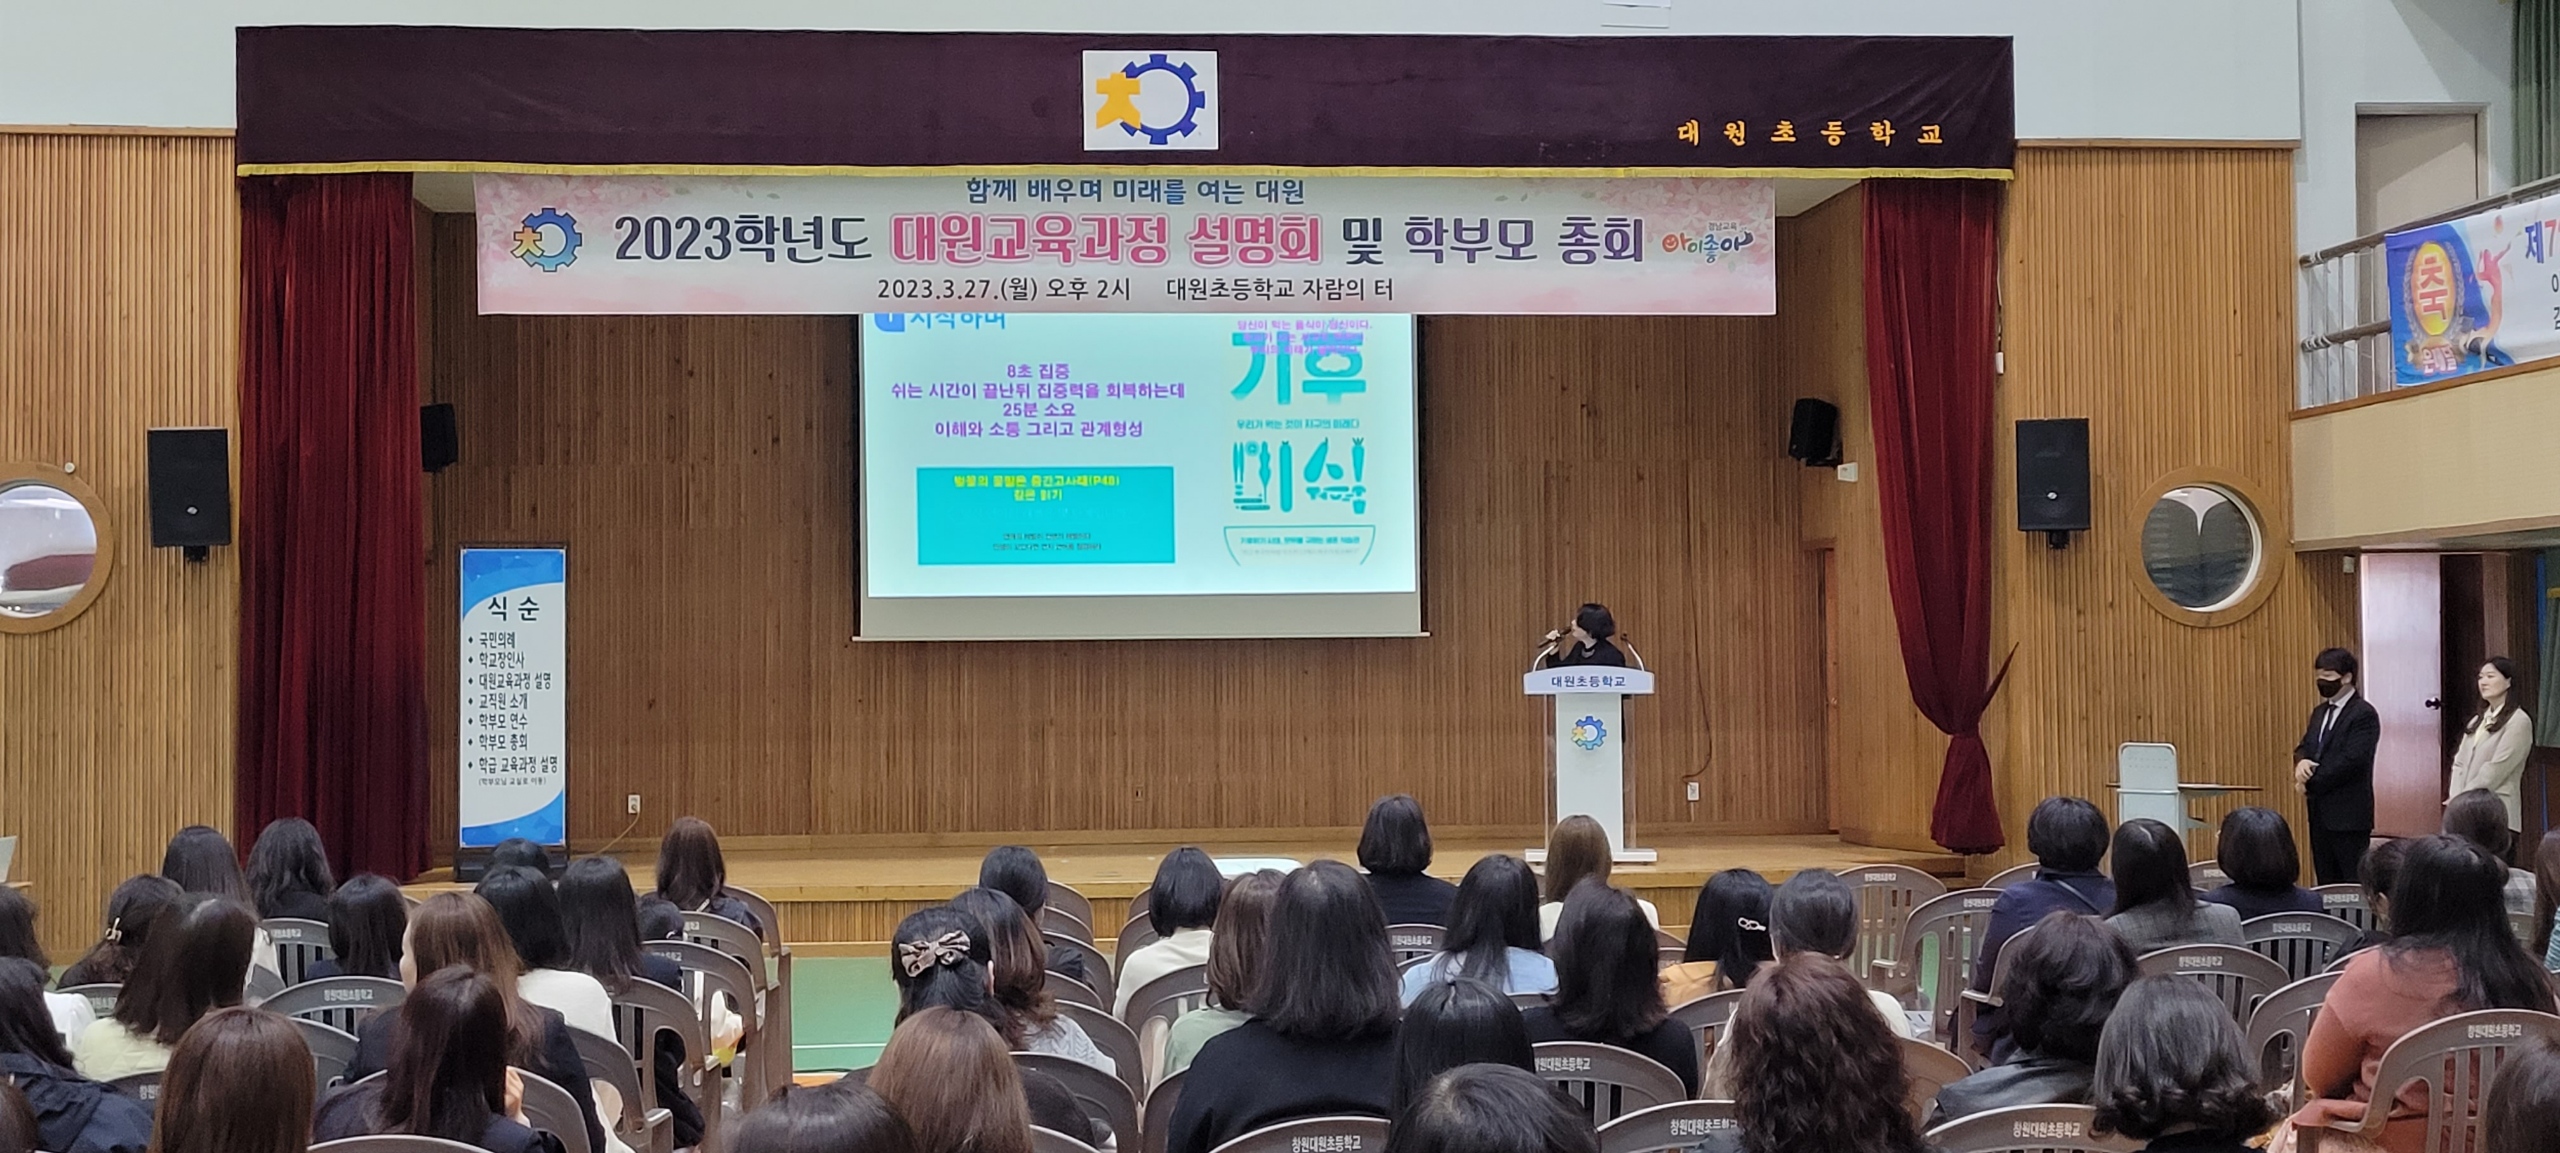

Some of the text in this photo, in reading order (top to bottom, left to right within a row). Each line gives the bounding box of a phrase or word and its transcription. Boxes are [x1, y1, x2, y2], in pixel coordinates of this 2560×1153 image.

[966, 178, 1305, 204] 함께 배우며 미래를 여는 대원
[615, 211, 1645, 267] 2023학년도 대원교육과정 설명회 및 학부모 총회
[1662, 231, 1754, 264] 아이좋아
[2525, 219, 2560, 264] 제7
[877, 277, 1394, 302] 2023.3.27.(월) 오후 2시 대원초등학교 자람의 터
[2418, 256, 2449, 321] 축
[1007, 364, 1070, 379] 8초 집중
[1231, 331, 1366, 405] 기후
[891, 383, 1185, 399] 쉬는 시간이 끝난뒤 집중력을 회복하는데
[1003, 403, 1076, 418] 25분 소요
[935, 422, 1143, 438] 이해와 소통 그리고 관계형성
[479, 632, 516, 649] 국민의례
[479, 651, 525, 669] 학교장인사
[479, 672, 551, 690] 대원교육과정 설명
[1551, 675, 1627, 688] 대원초등학교
[479, 693, 528, 710] 교직원 소개
[479, 713, 528, 731] 학부모 연수
[479, 734, 528, 751] 학부모 총회
[479, 756, 558, 774] 학급 교육과정 설명
[2013, 1121, 2081, 1138] 창원대원초등학교
[1292, 1135, 1362, 1153] 창원대원초등학교
